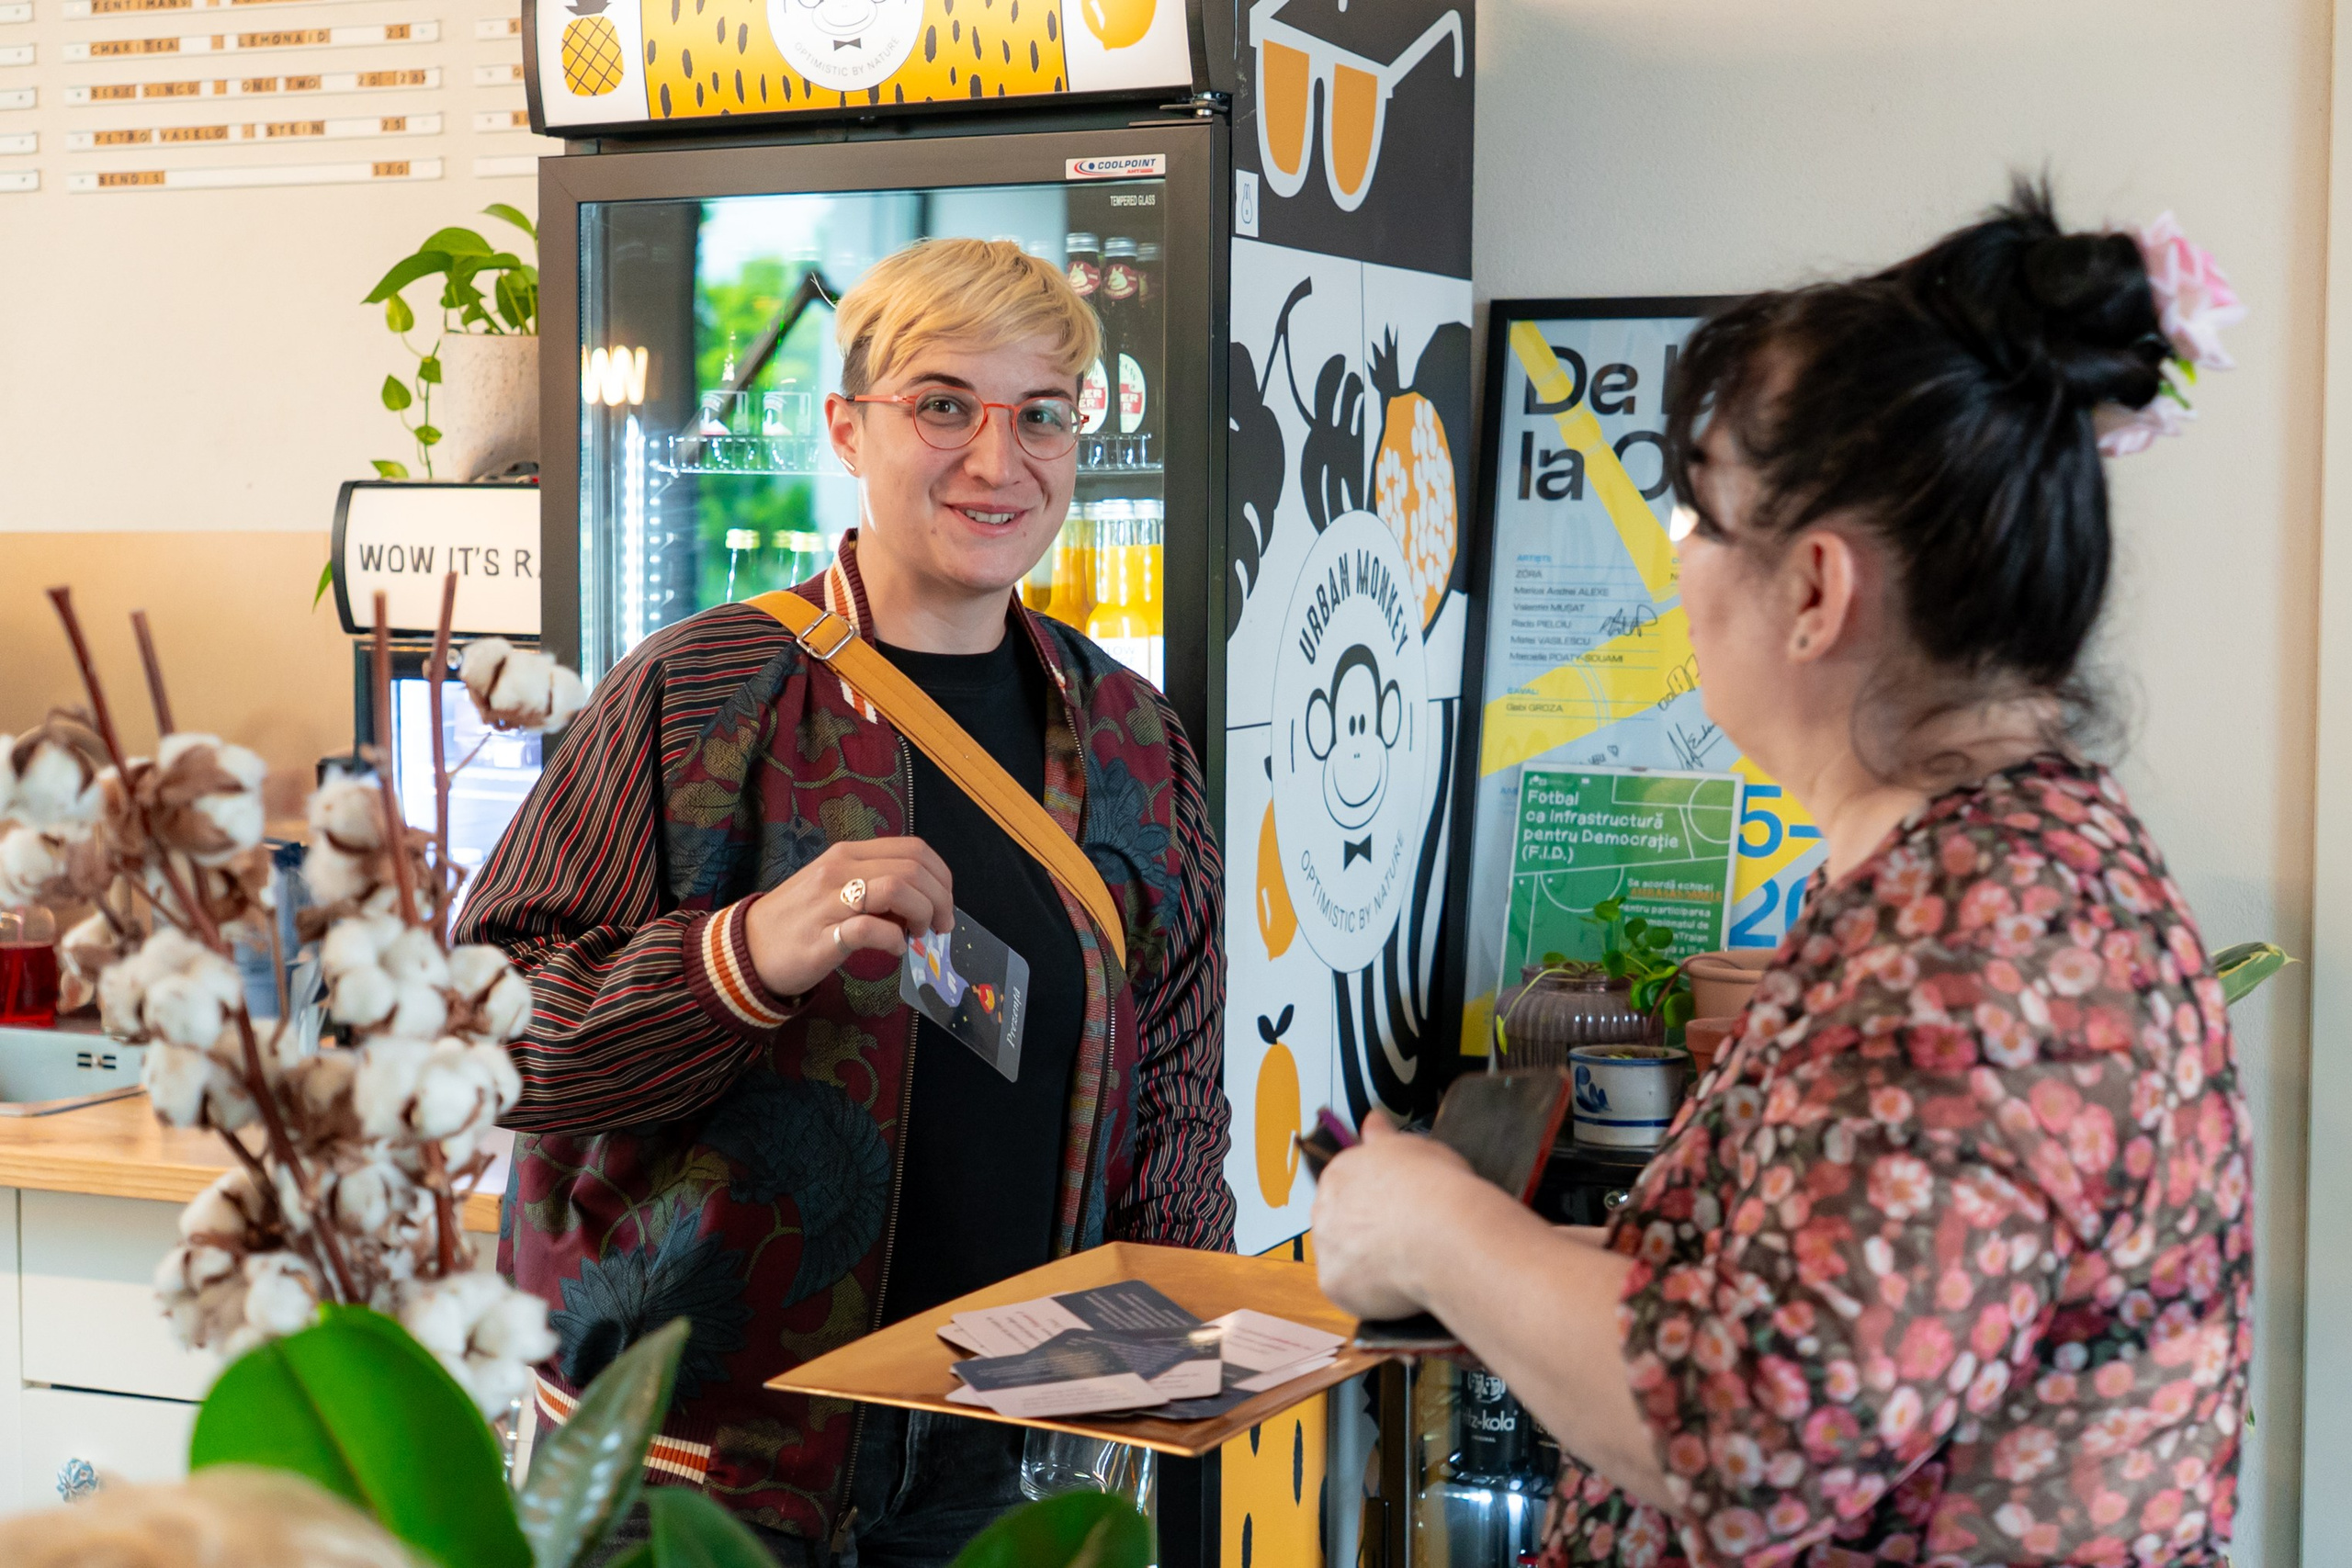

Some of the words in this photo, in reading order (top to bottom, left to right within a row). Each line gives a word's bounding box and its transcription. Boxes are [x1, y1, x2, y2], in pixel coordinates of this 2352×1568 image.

[794, 41, 848, 76] OPTIMISTIC
[853, 65, 865, 75] BY
[867, 36, 899, 70] NATURE
[1097, 158, 1156, 170] COOLPOINT
[1110, 195, 1137, 207] TEMPERED
[1137, 194, 1156, 206] GLASS
[1523, 345, 1639, 416] De
[1518, 430, 1585, 502] la
[359, 544, 434, 574] WOW
[448, 547, 500, 577] IT'S
[514, 549, 540, 579] R
[1299, 552, 1351, 665] URBAN
[1356, 548, 1408, 657] MONKEY
[1528, 789, 1579, 806] Fotbal
[1525, 811, 1545, 823] ca
[1523, 829, 1578, 843] pentru
[1521, 844, 1575, 864] (F.I.D.)
[1301, 850, 1355, 933] OPTIMISTIC
[1359, 903, 1372, 931] BY
[1374, 829, 1405, 910] NATURE
[1651, 906, 1712, 918] participarea
